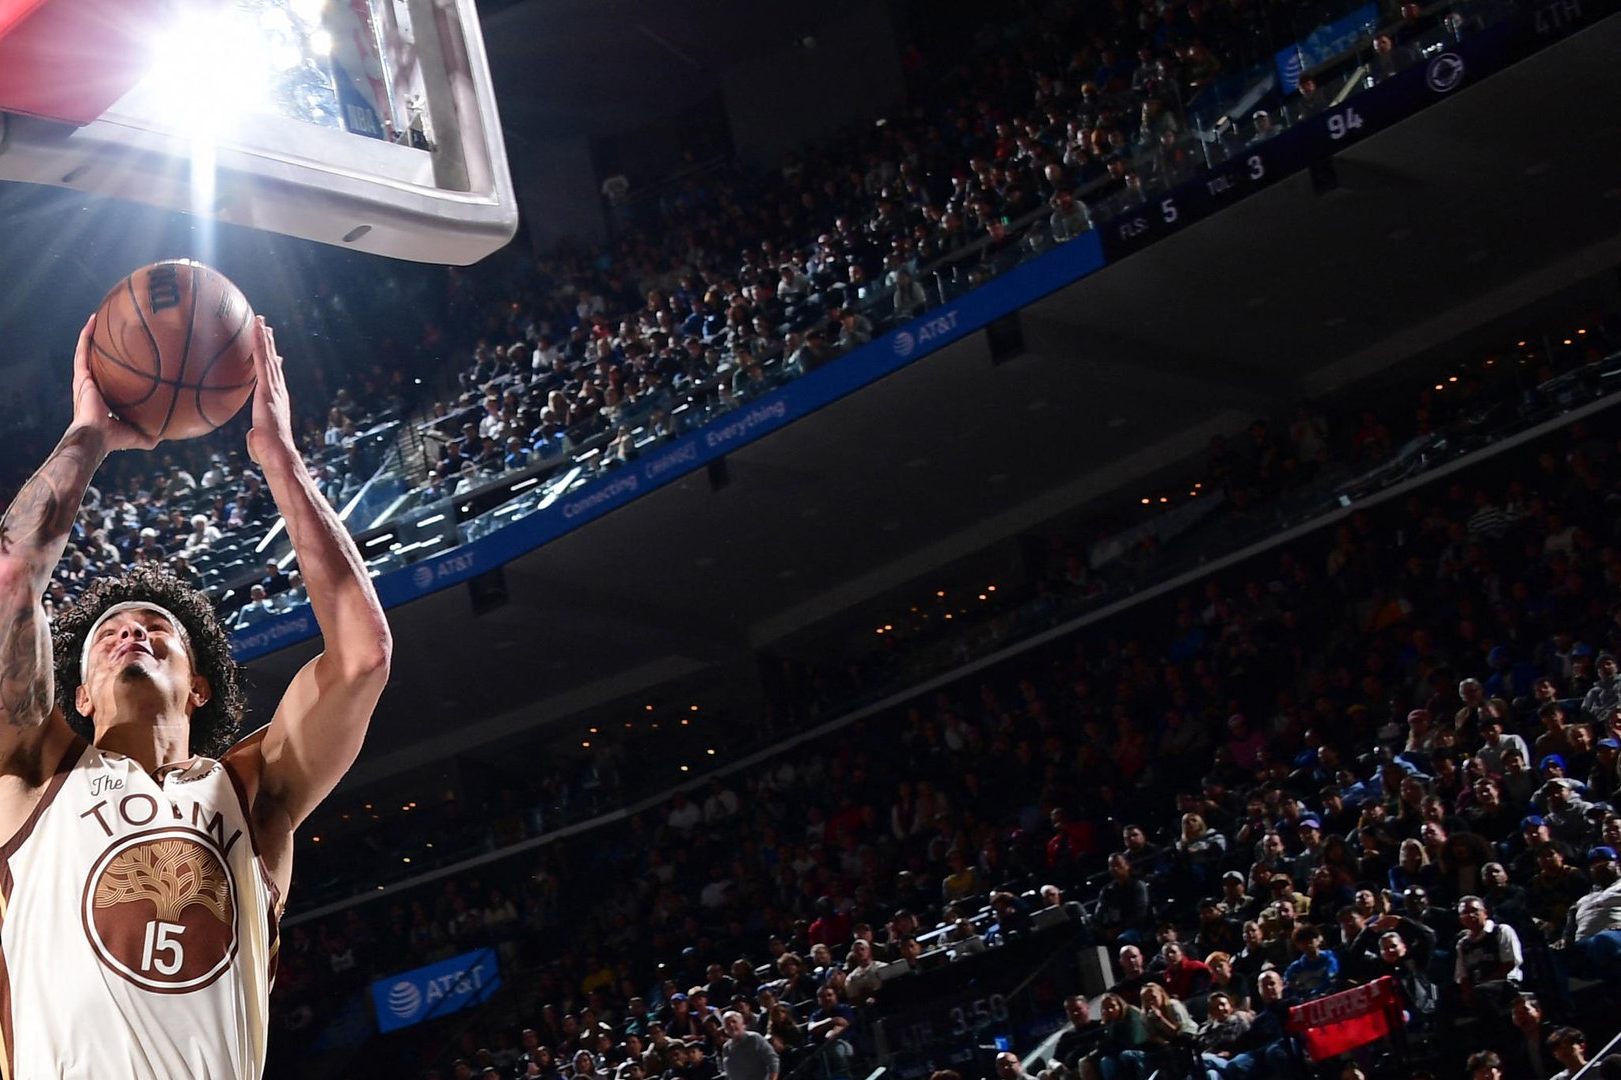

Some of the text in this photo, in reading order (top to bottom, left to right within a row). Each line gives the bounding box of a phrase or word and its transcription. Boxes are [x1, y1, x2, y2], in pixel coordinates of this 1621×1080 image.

[1328, 107, 1364, 140] 94
[1247, 154, 1265, 180] 3
[1162, 198, 1178, 223] 5
[919, 309, 958, 345] AT&T
[90, 774, 124, 797] The
[140, 920, 186, 976] 15
[425, 964, 485, 1005] AT&T
